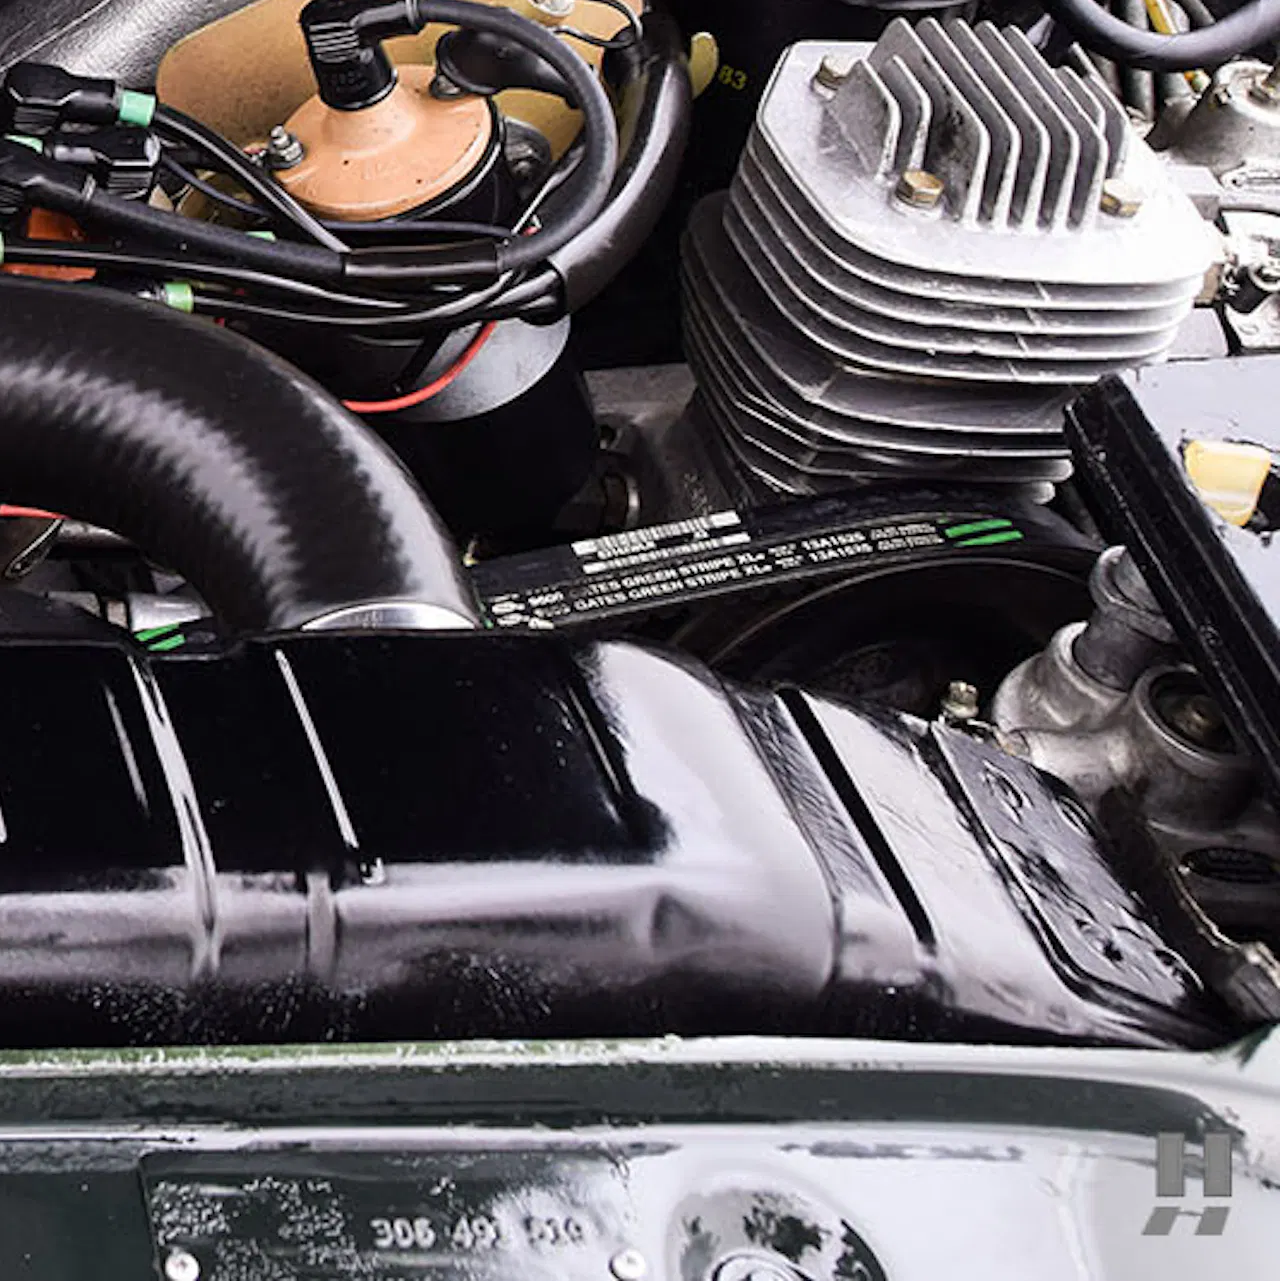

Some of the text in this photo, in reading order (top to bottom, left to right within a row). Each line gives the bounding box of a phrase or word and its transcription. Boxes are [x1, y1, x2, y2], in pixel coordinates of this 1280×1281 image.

[621, 568, 677, 588] GREEN
[679, 556, 736, 576] STRIPE
[574, 592, 628, 611] GATES
[628, 580, 684, 600] GREEN
[685, 567, 743, 588] STRIPE
[371, 1218, 436, 1249] 306
